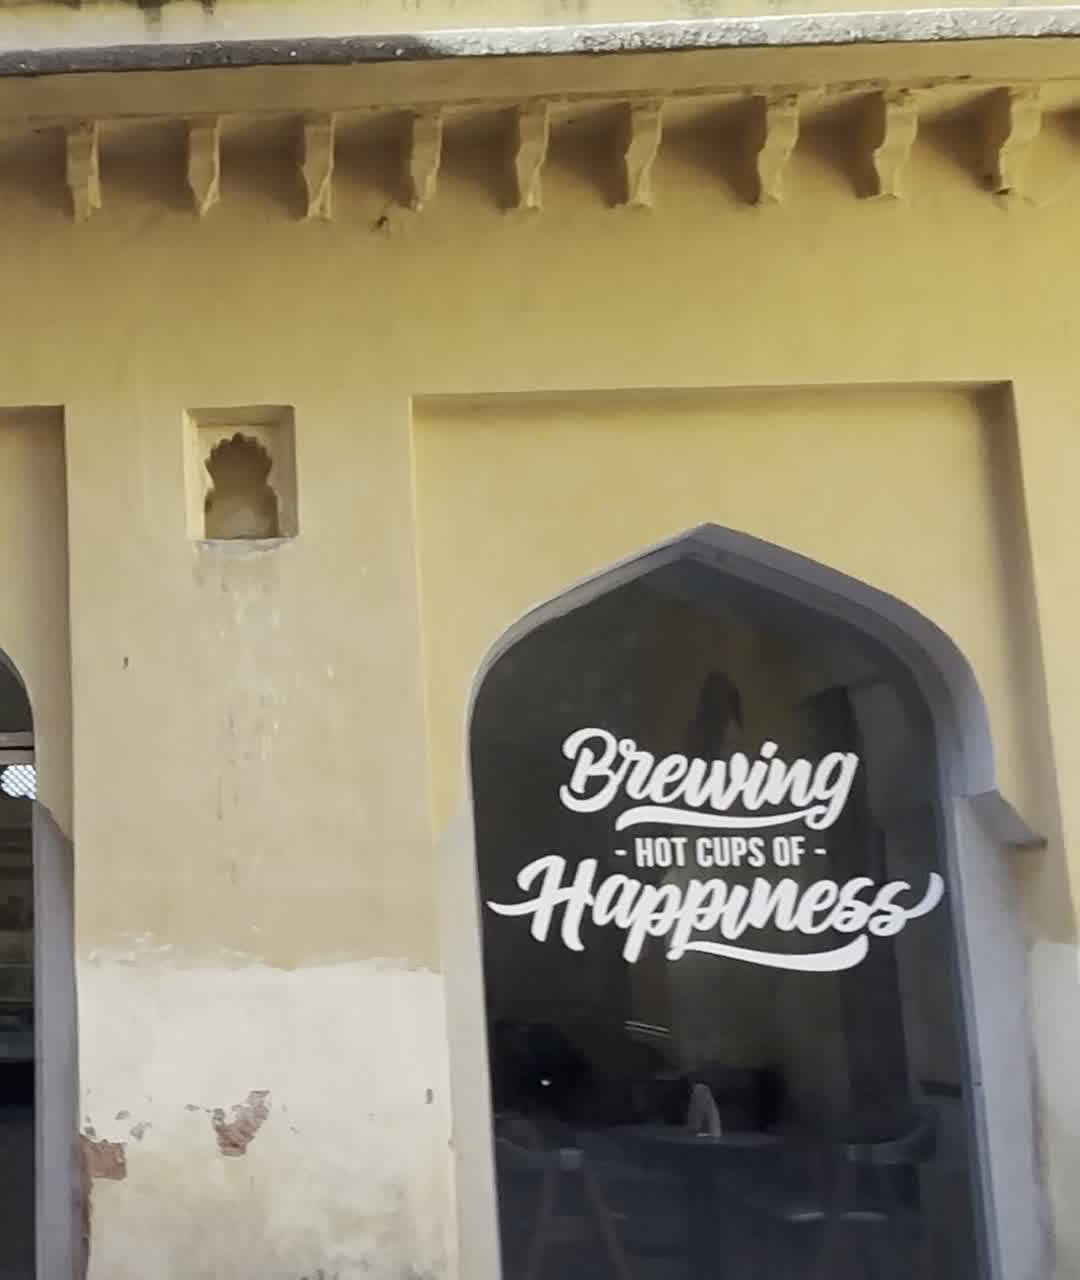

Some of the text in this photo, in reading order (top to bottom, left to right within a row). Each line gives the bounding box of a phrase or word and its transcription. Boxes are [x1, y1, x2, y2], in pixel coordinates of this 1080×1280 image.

[559, 727, 859, 831] Brewing
[635, 835, 806, 868] HOT CUPS OF
[486, 854, 944, 972] Happiness
